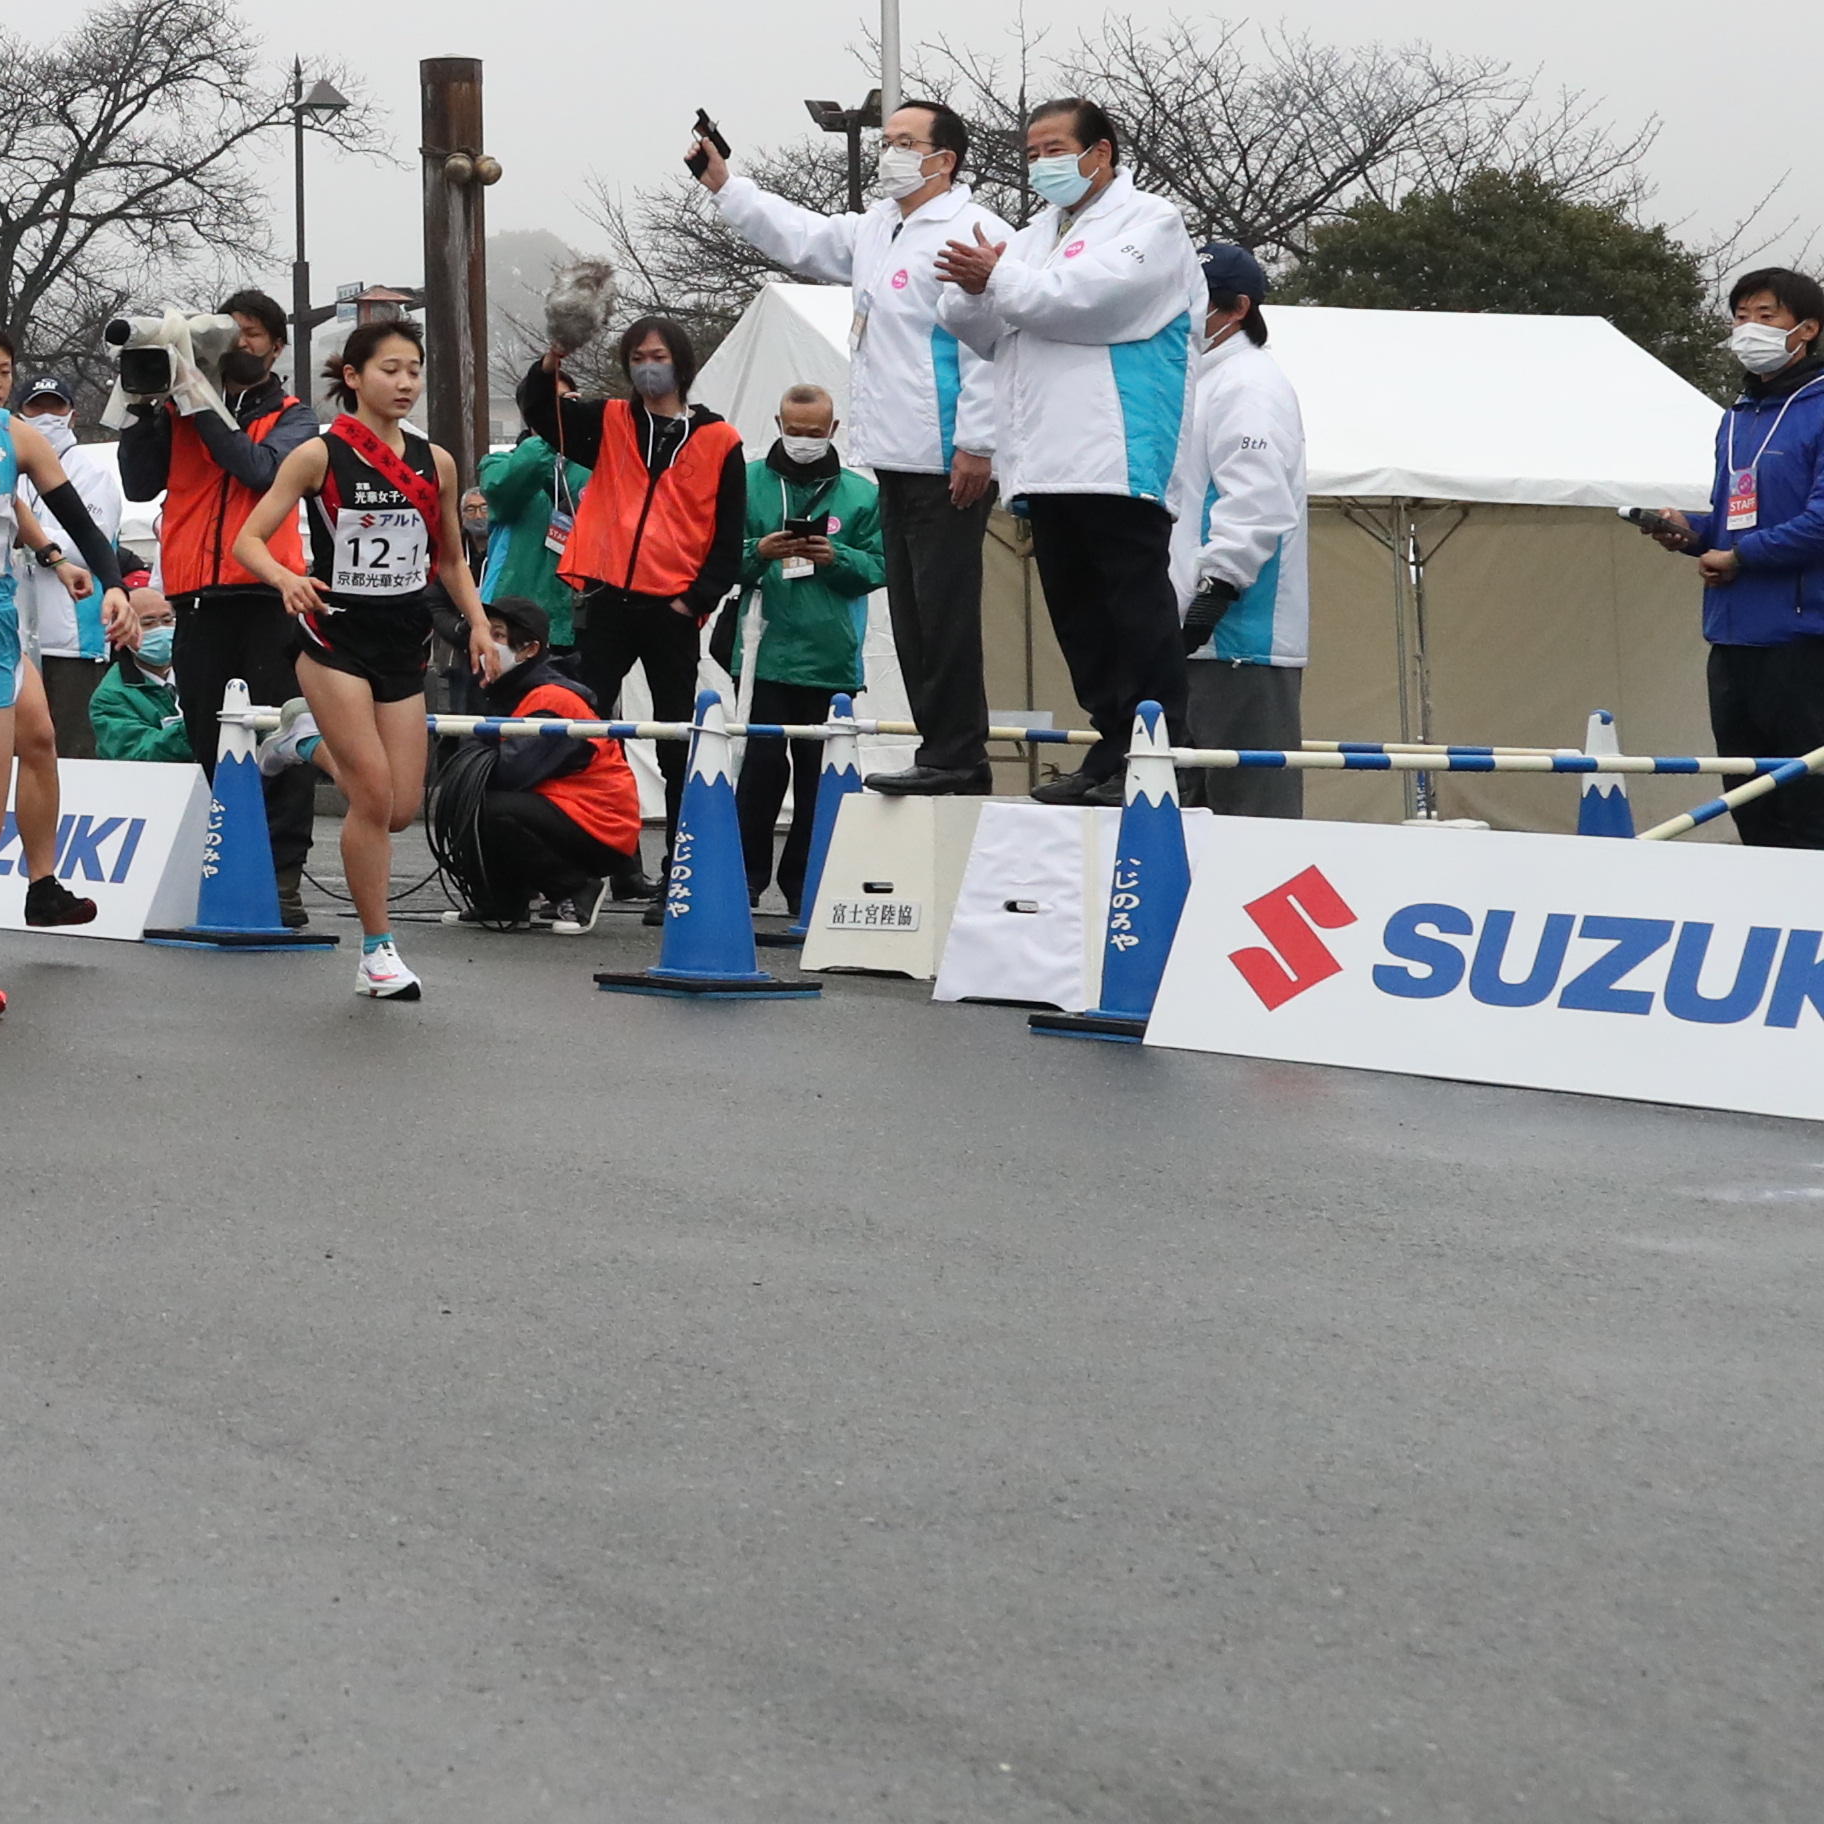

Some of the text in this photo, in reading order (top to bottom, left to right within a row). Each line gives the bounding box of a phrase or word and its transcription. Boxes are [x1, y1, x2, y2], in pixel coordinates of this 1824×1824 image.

[1120, 244, 1145, 265] 8th
[1241, 436, 1267, 450] 8th
[379, 514, 421, 527] アルト
[347, 537, 419, 569] 12-1
[337, 570, 422, 588] 京都光華女子大
[202, 798, 226, 879] ふじのみや
[667, 821, 695, 918] ふじのみや
[832, 903, 913, 926] 富士宮陸協
